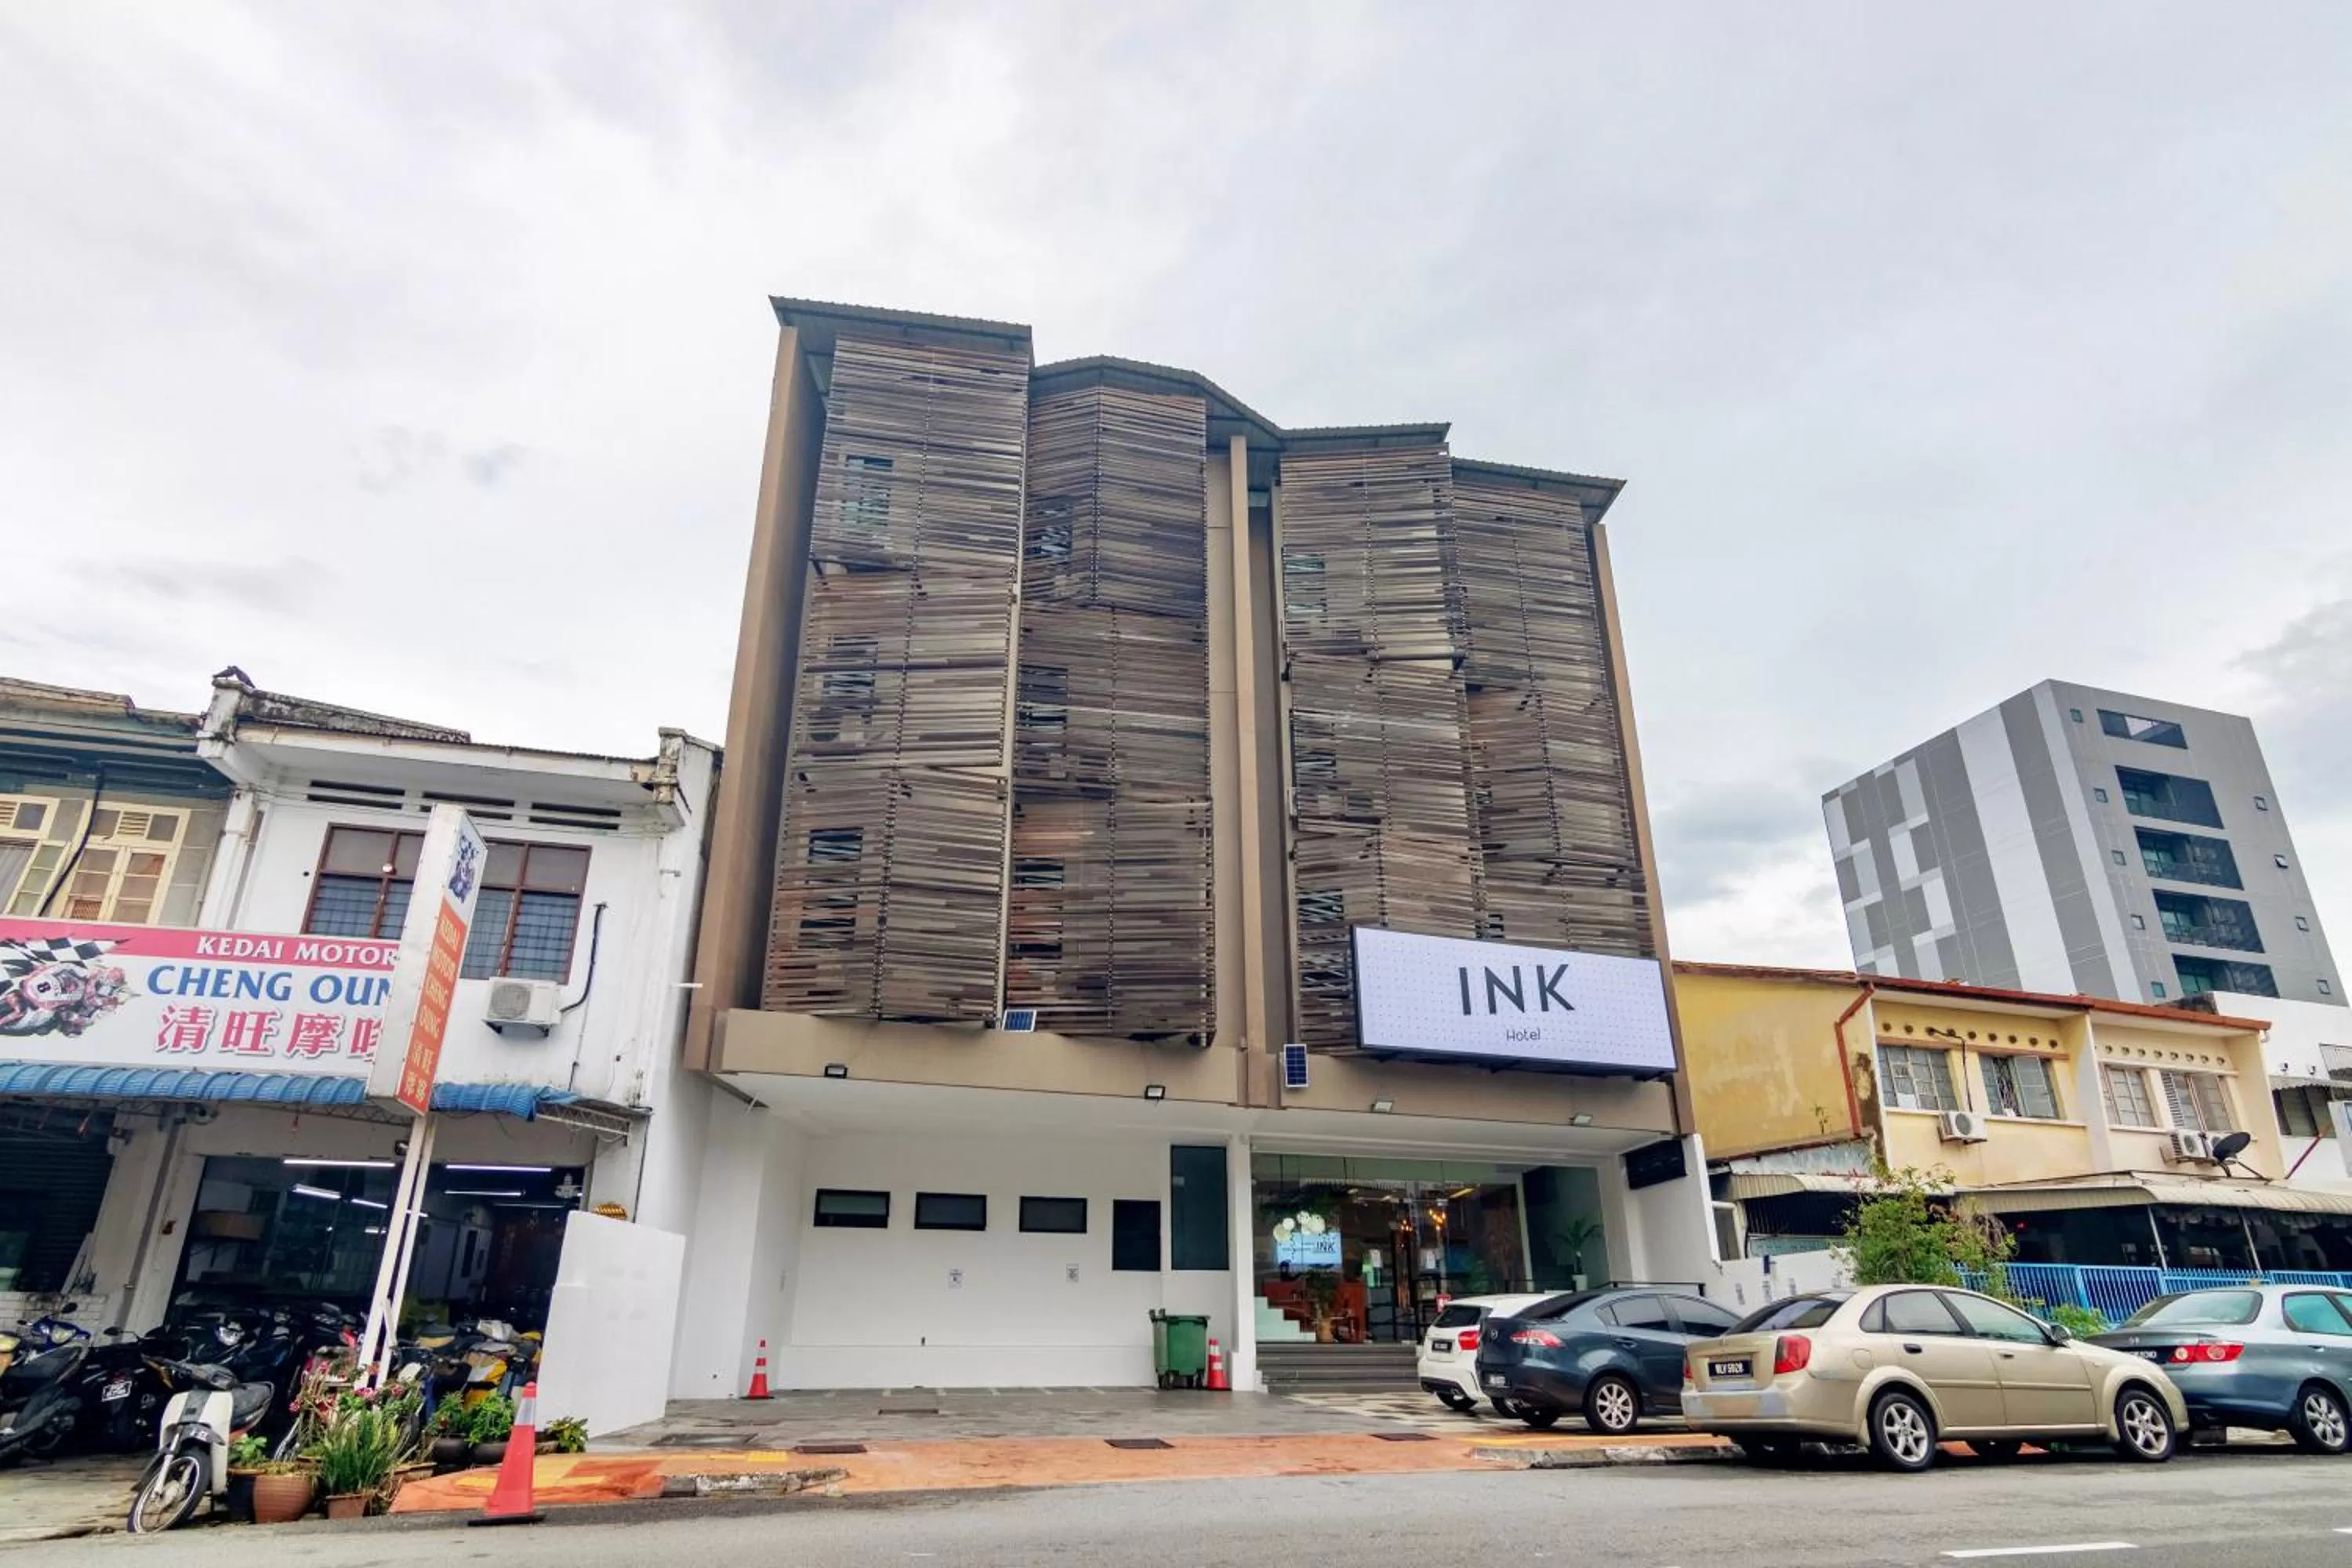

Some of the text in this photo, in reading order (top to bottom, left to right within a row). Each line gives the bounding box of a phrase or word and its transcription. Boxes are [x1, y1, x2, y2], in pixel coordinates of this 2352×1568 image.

[197, 936, 400, 966] KEDAI MOTOR
[147, 965, 292, 1001] CHENG
[1458, 964, 1575, 1016] INK
[1506, 1028, 1541, 1042] Hotel
